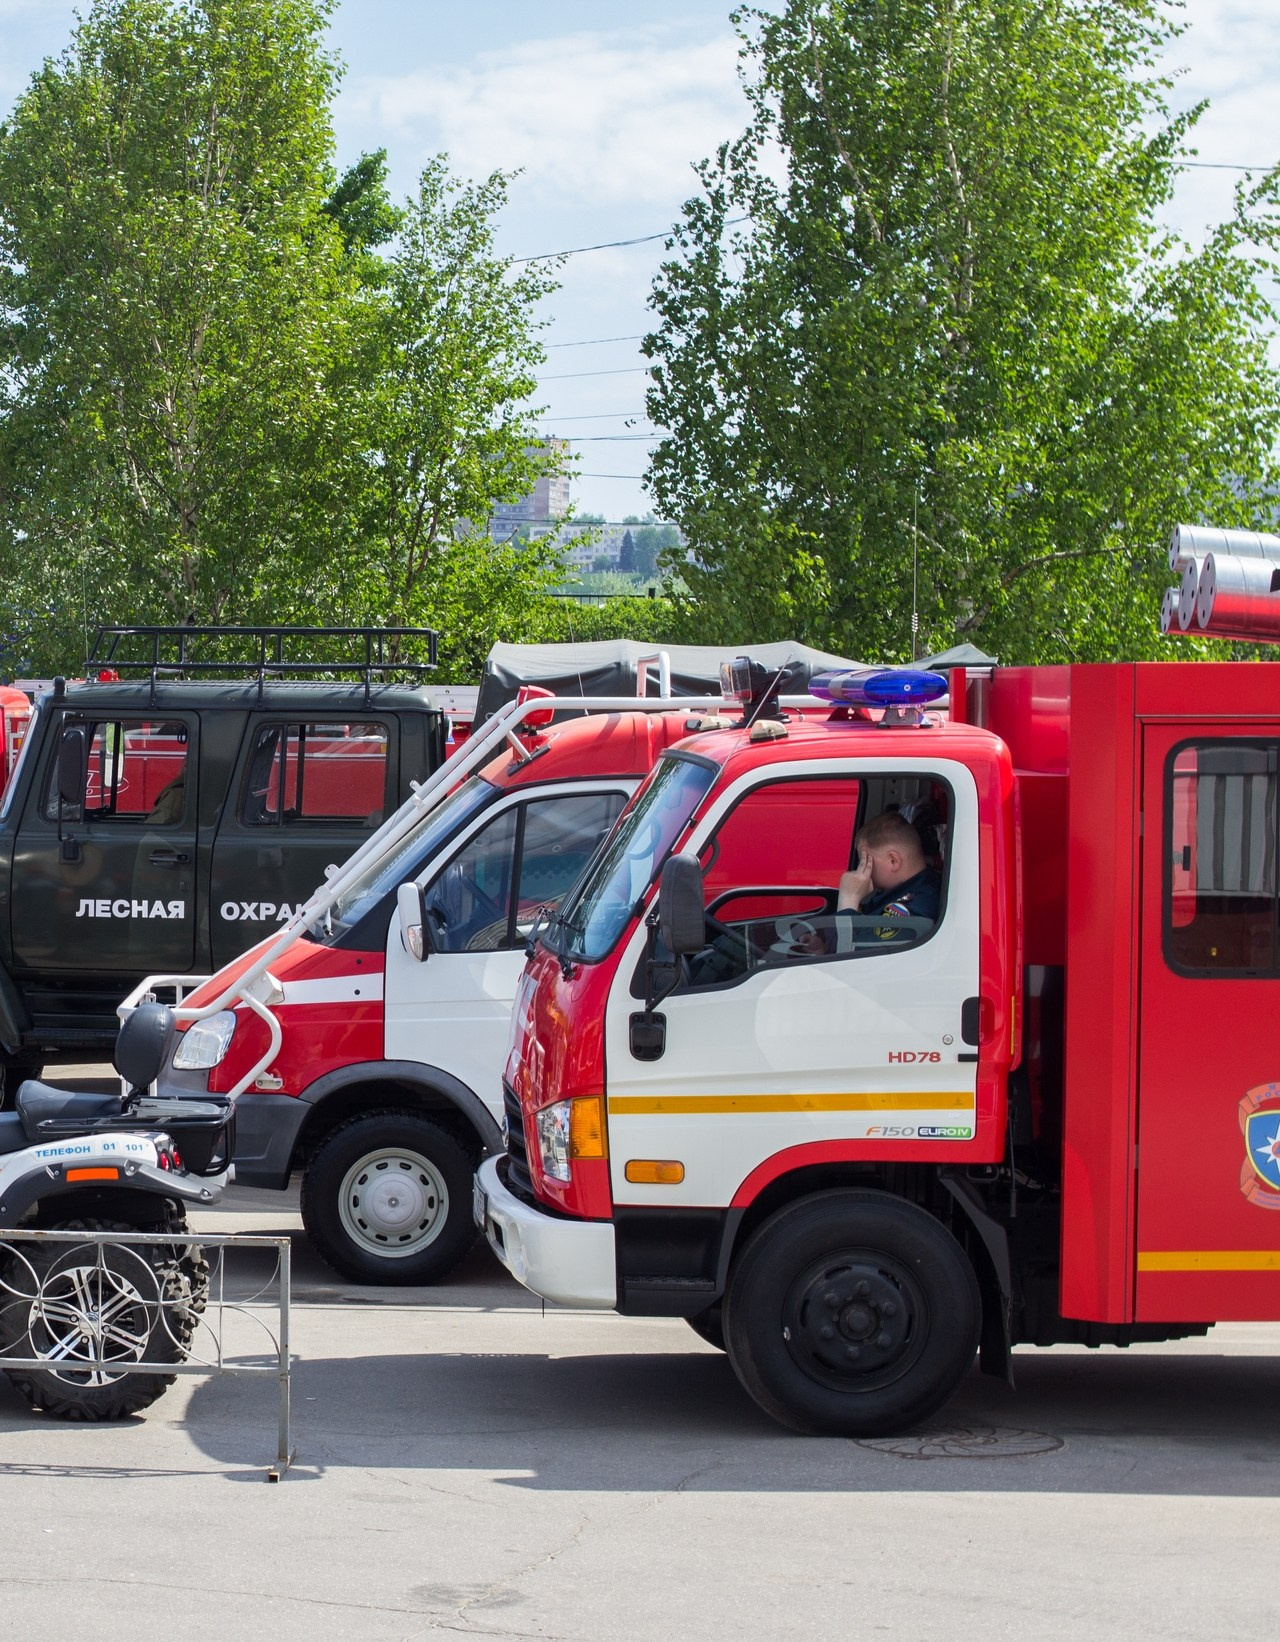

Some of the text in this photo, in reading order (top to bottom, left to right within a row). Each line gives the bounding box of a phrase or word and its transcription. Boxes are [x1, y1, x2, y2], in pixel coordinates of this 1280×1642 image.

[75, 898, 185, 919] ЛЕСНАЯ
[888, 1051, 942, 1063] HD78
[866, 1126, 969, 1137] F150 EURO IV
[35, 1145, 91, 1158] ТЕЛЕФОН
[103, 1143, 116, 1151] 01
